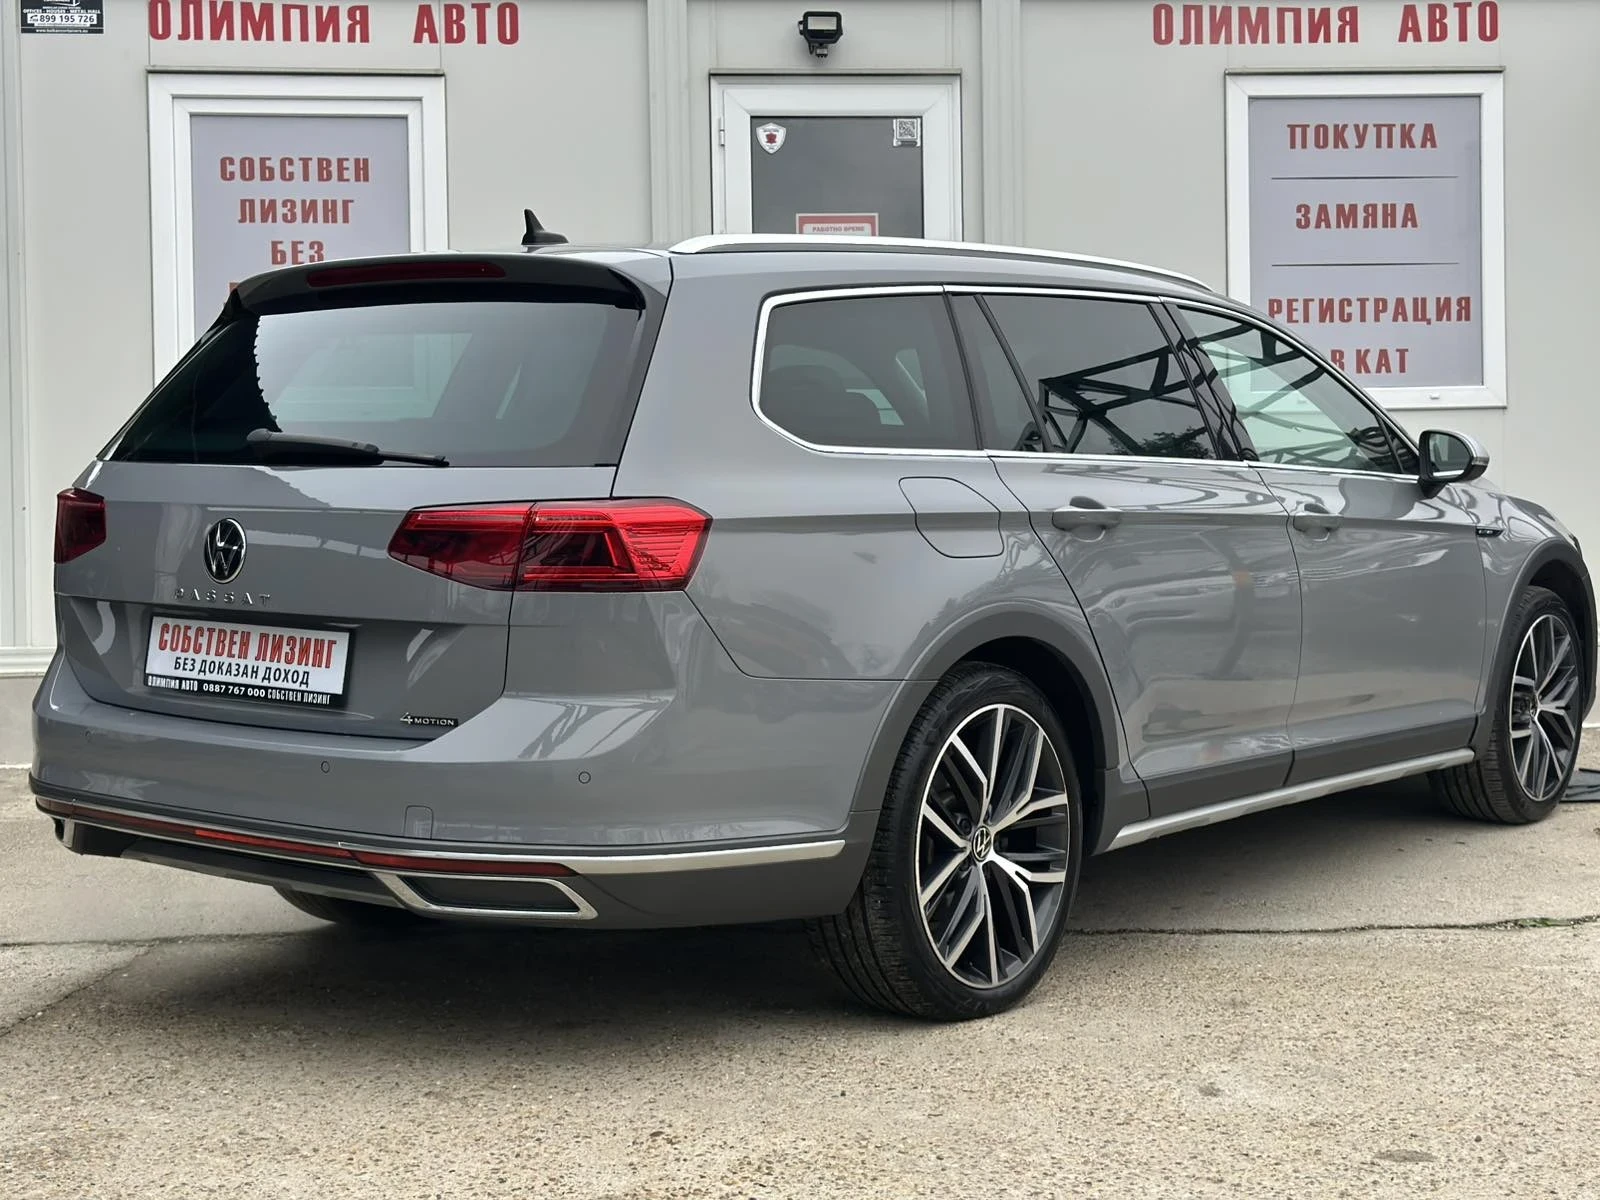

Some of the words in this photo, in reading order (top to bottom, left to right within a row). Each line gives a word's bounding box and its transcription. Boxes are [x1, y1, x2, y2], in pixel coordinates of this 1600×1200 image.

[39, 14, 56, 22] 899
[59, 15, 75, 23] 195
[78, 15, 95, 23] 726
[148, 0, 370, 43] ОЛИМПИЯ
[413, 2, 520, 45] АВТО
[1152, 3, 1360, 45] ОЛИМПИЯ
[1398, 0, 1499, 43] АВТО
[1287, 123, 1438, 149] ПОКУПКА
[220, 156, 370, 182] СОБСТВЕН
[238, 199, 355, 224] ЛИЗИНГ
[1296, 203, 1419, 229] ЗАМЯНА
[271, 240, 325, 265] БЕЗ
[1268, 296, 1472, 325] РЕГИСТРАЦИЯ
[1355, 348, 1409, 374] КАТ
[174, 587, 271, 606] PASSAT
[158, 622, 252, 660] СОБСТВЕН
[255, 632, 337, 669] ЛИЗИНГ
[174, 656, 197, 672] БЕЗ
[198, 660, 259, 681] ДОКАЗАН
[262, 666, 310, 688] ДОХОД
[147, 675, 180, 690] ОЛИМПИЯ
[181, 679, 198, 692] АВТО
[203, 683, 226, 693] 0887
[228, 686, 245, 696] 767
[247, 688, 266, 698] 000
[267, 688, 302, 703] СОБСТВЕН
[303, 692, 331, 705] ЛИЗИНГ
[400, 712, 455, 726] 4MOTION
